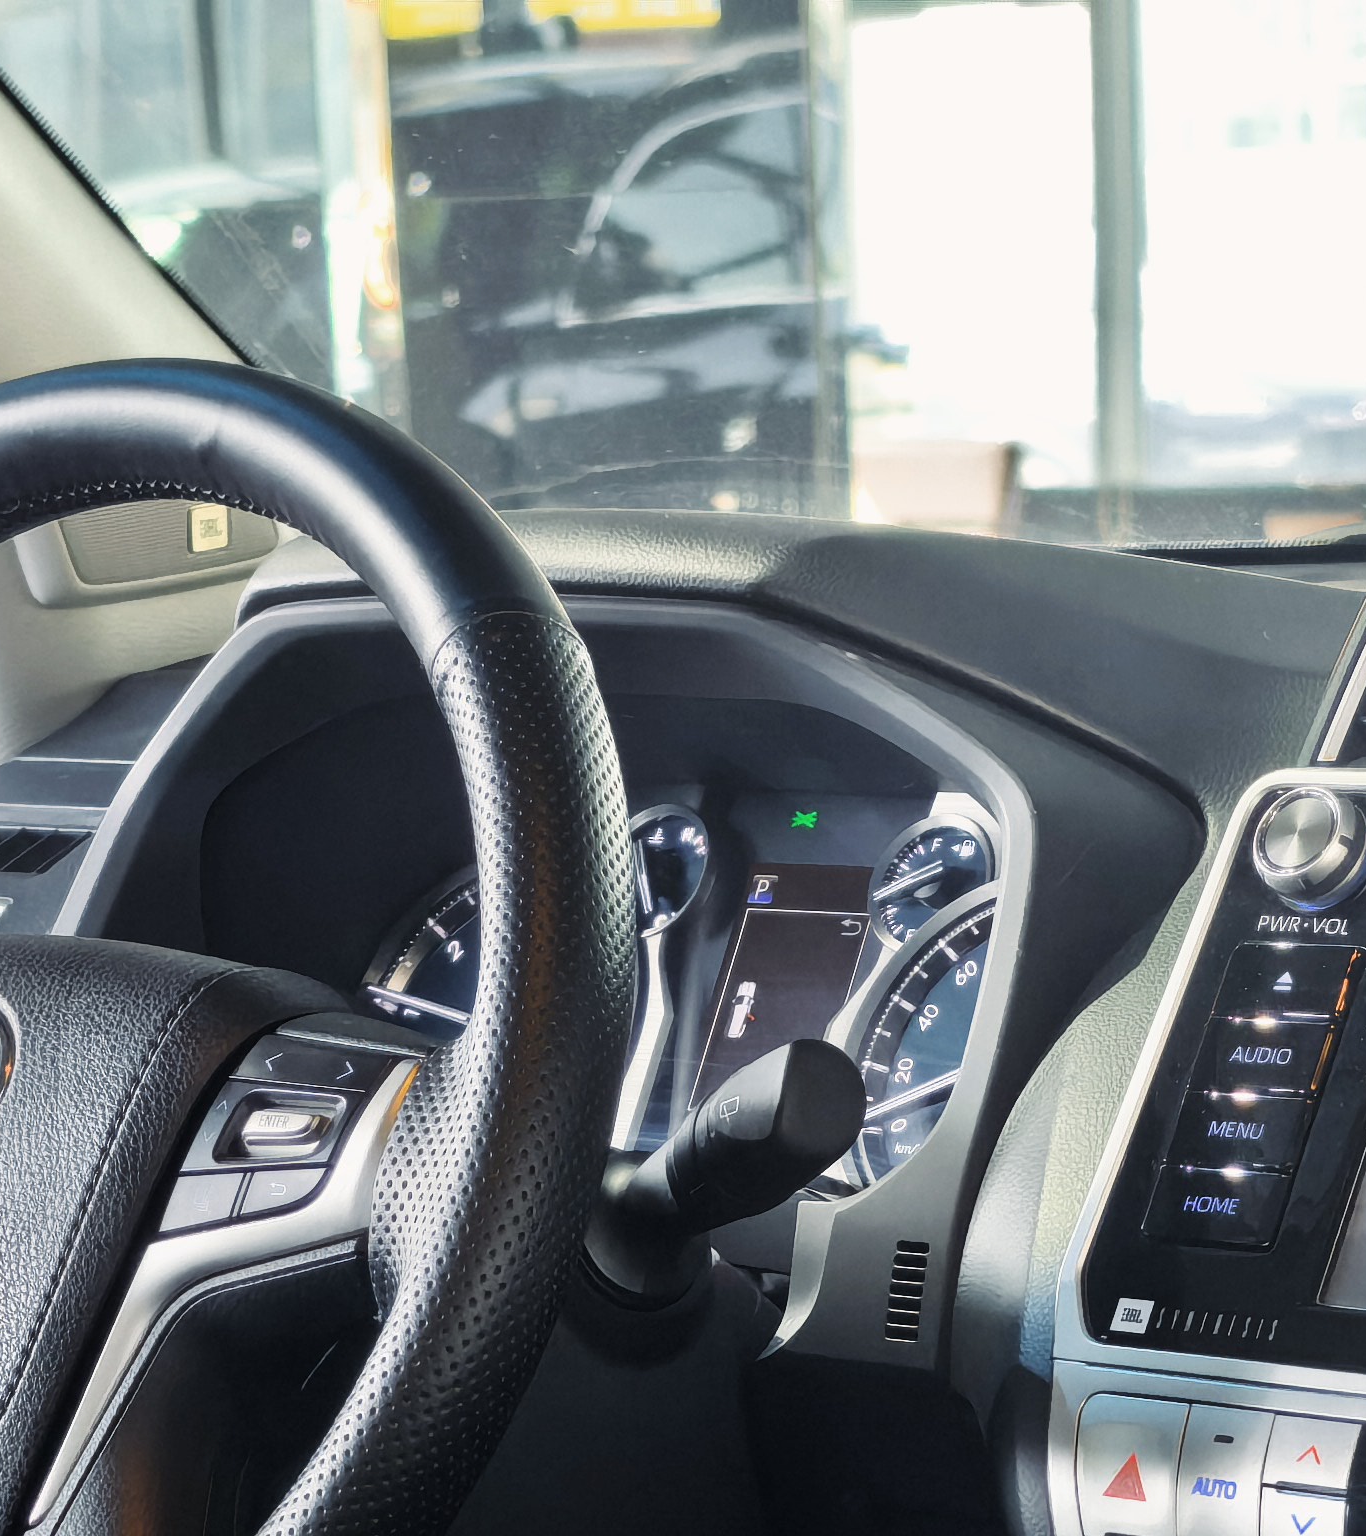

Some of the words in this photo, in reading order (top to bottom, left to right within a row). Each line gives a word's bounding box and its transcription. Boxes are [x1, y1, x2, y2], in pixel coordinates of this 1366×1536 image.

[931, 837, 943, 852] F
[753, 879, 770, 901] P
[447, 940, 465, 962] 2
[955, 960, 978, 986] 60
[918, 1004, 939, 1032] 40
[1230, 1045, 1292, 1065] AUDIO
[895, 1057, 914, 1084] 20
[259, 1114, 289, 1129] ENTER
[890, 1118, 907, 1133] 0
[1207, 1120, 1265, 1140] MENU
[894, 1141, 921, 1155] km/
[1183, 1195, 1240, 1216] HOME
[1191, 1476, 1237, 1500] AUTO
